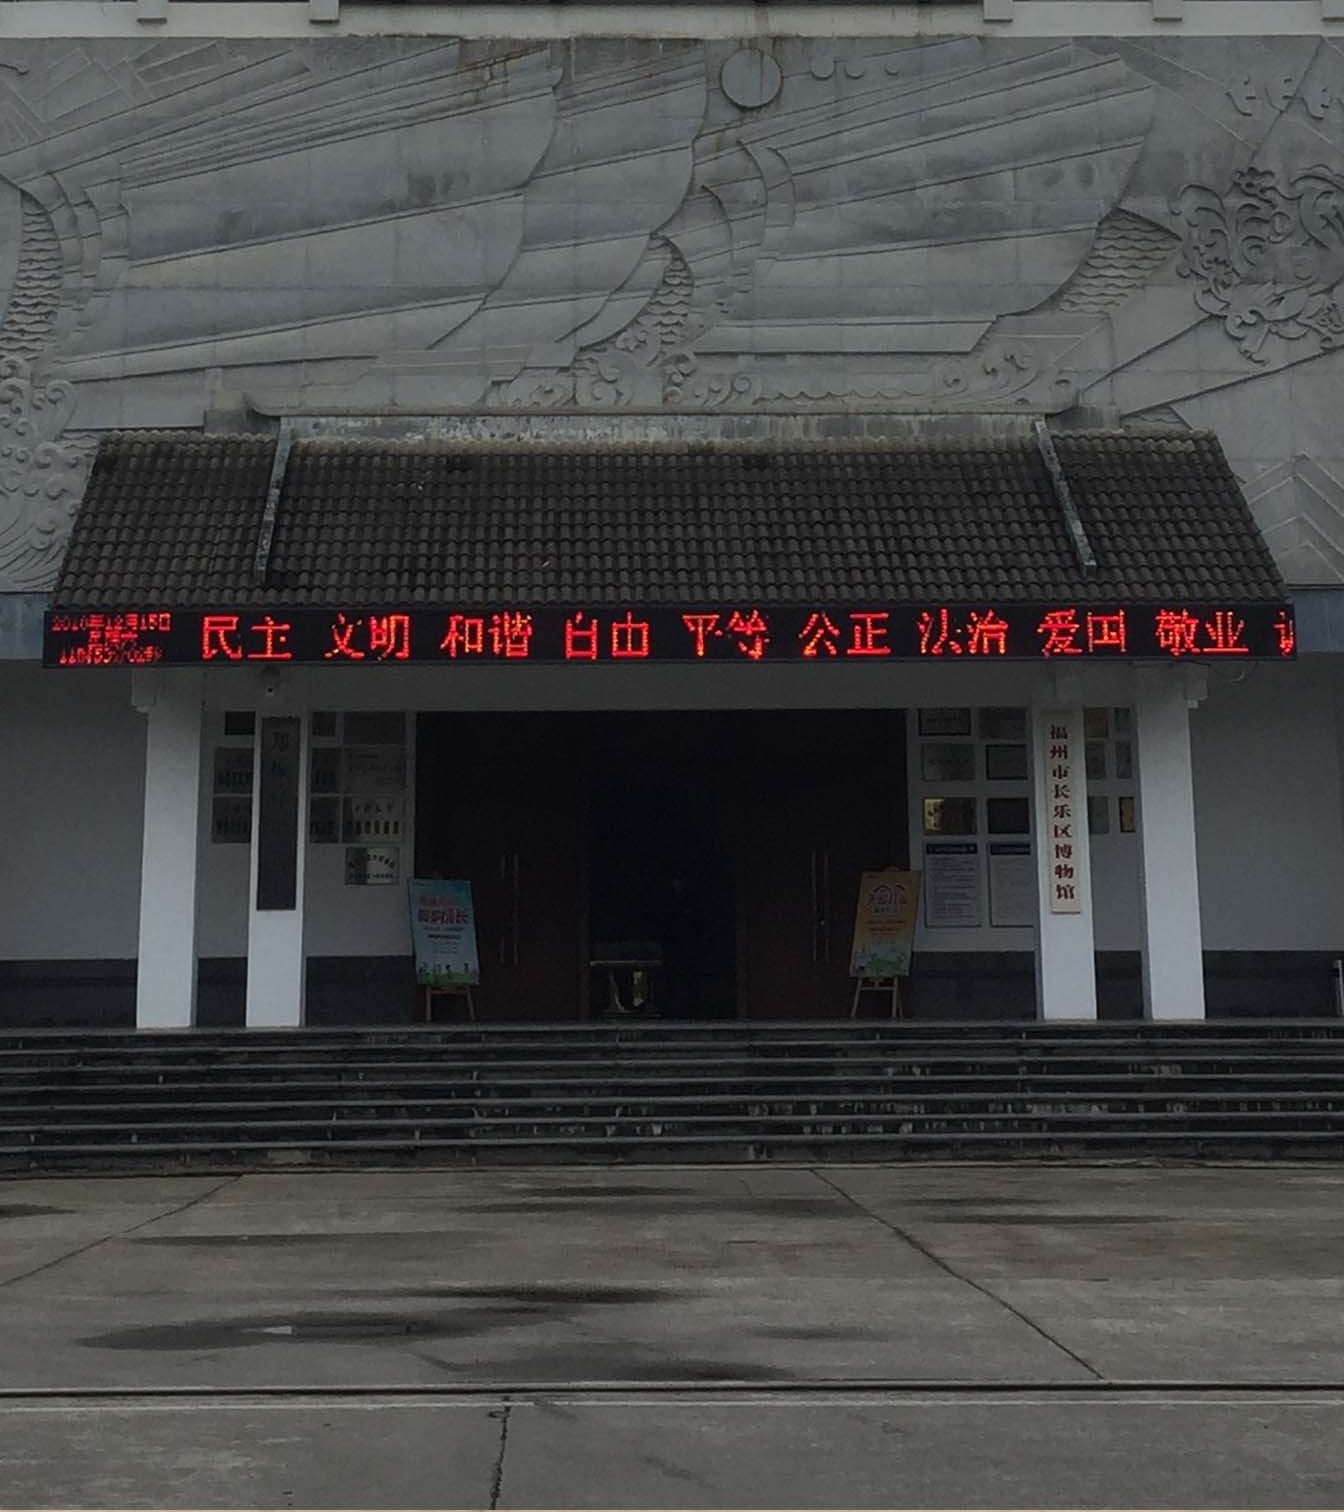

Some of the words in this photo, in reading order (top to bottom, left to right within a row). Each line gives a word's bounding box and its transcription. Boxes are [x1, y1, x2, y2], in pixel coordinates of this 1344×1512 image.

[202, 615, 292, 660] 民主
[325, 614, 410, 659] 文明
[440, 611, 533, 658] 和谐
[564, 612, 650, 660] 自由
[682, 609, 769, 661] 平等
[800, 612, 891, 657] 公正
[918, 608, 1009, 656] 法治
[1037, 608, 1126, 657] 爱国
[1156, 609, 1249, 656] 敬业
[1050, 724, 1076, 900] 福州市长乐区博物馆
